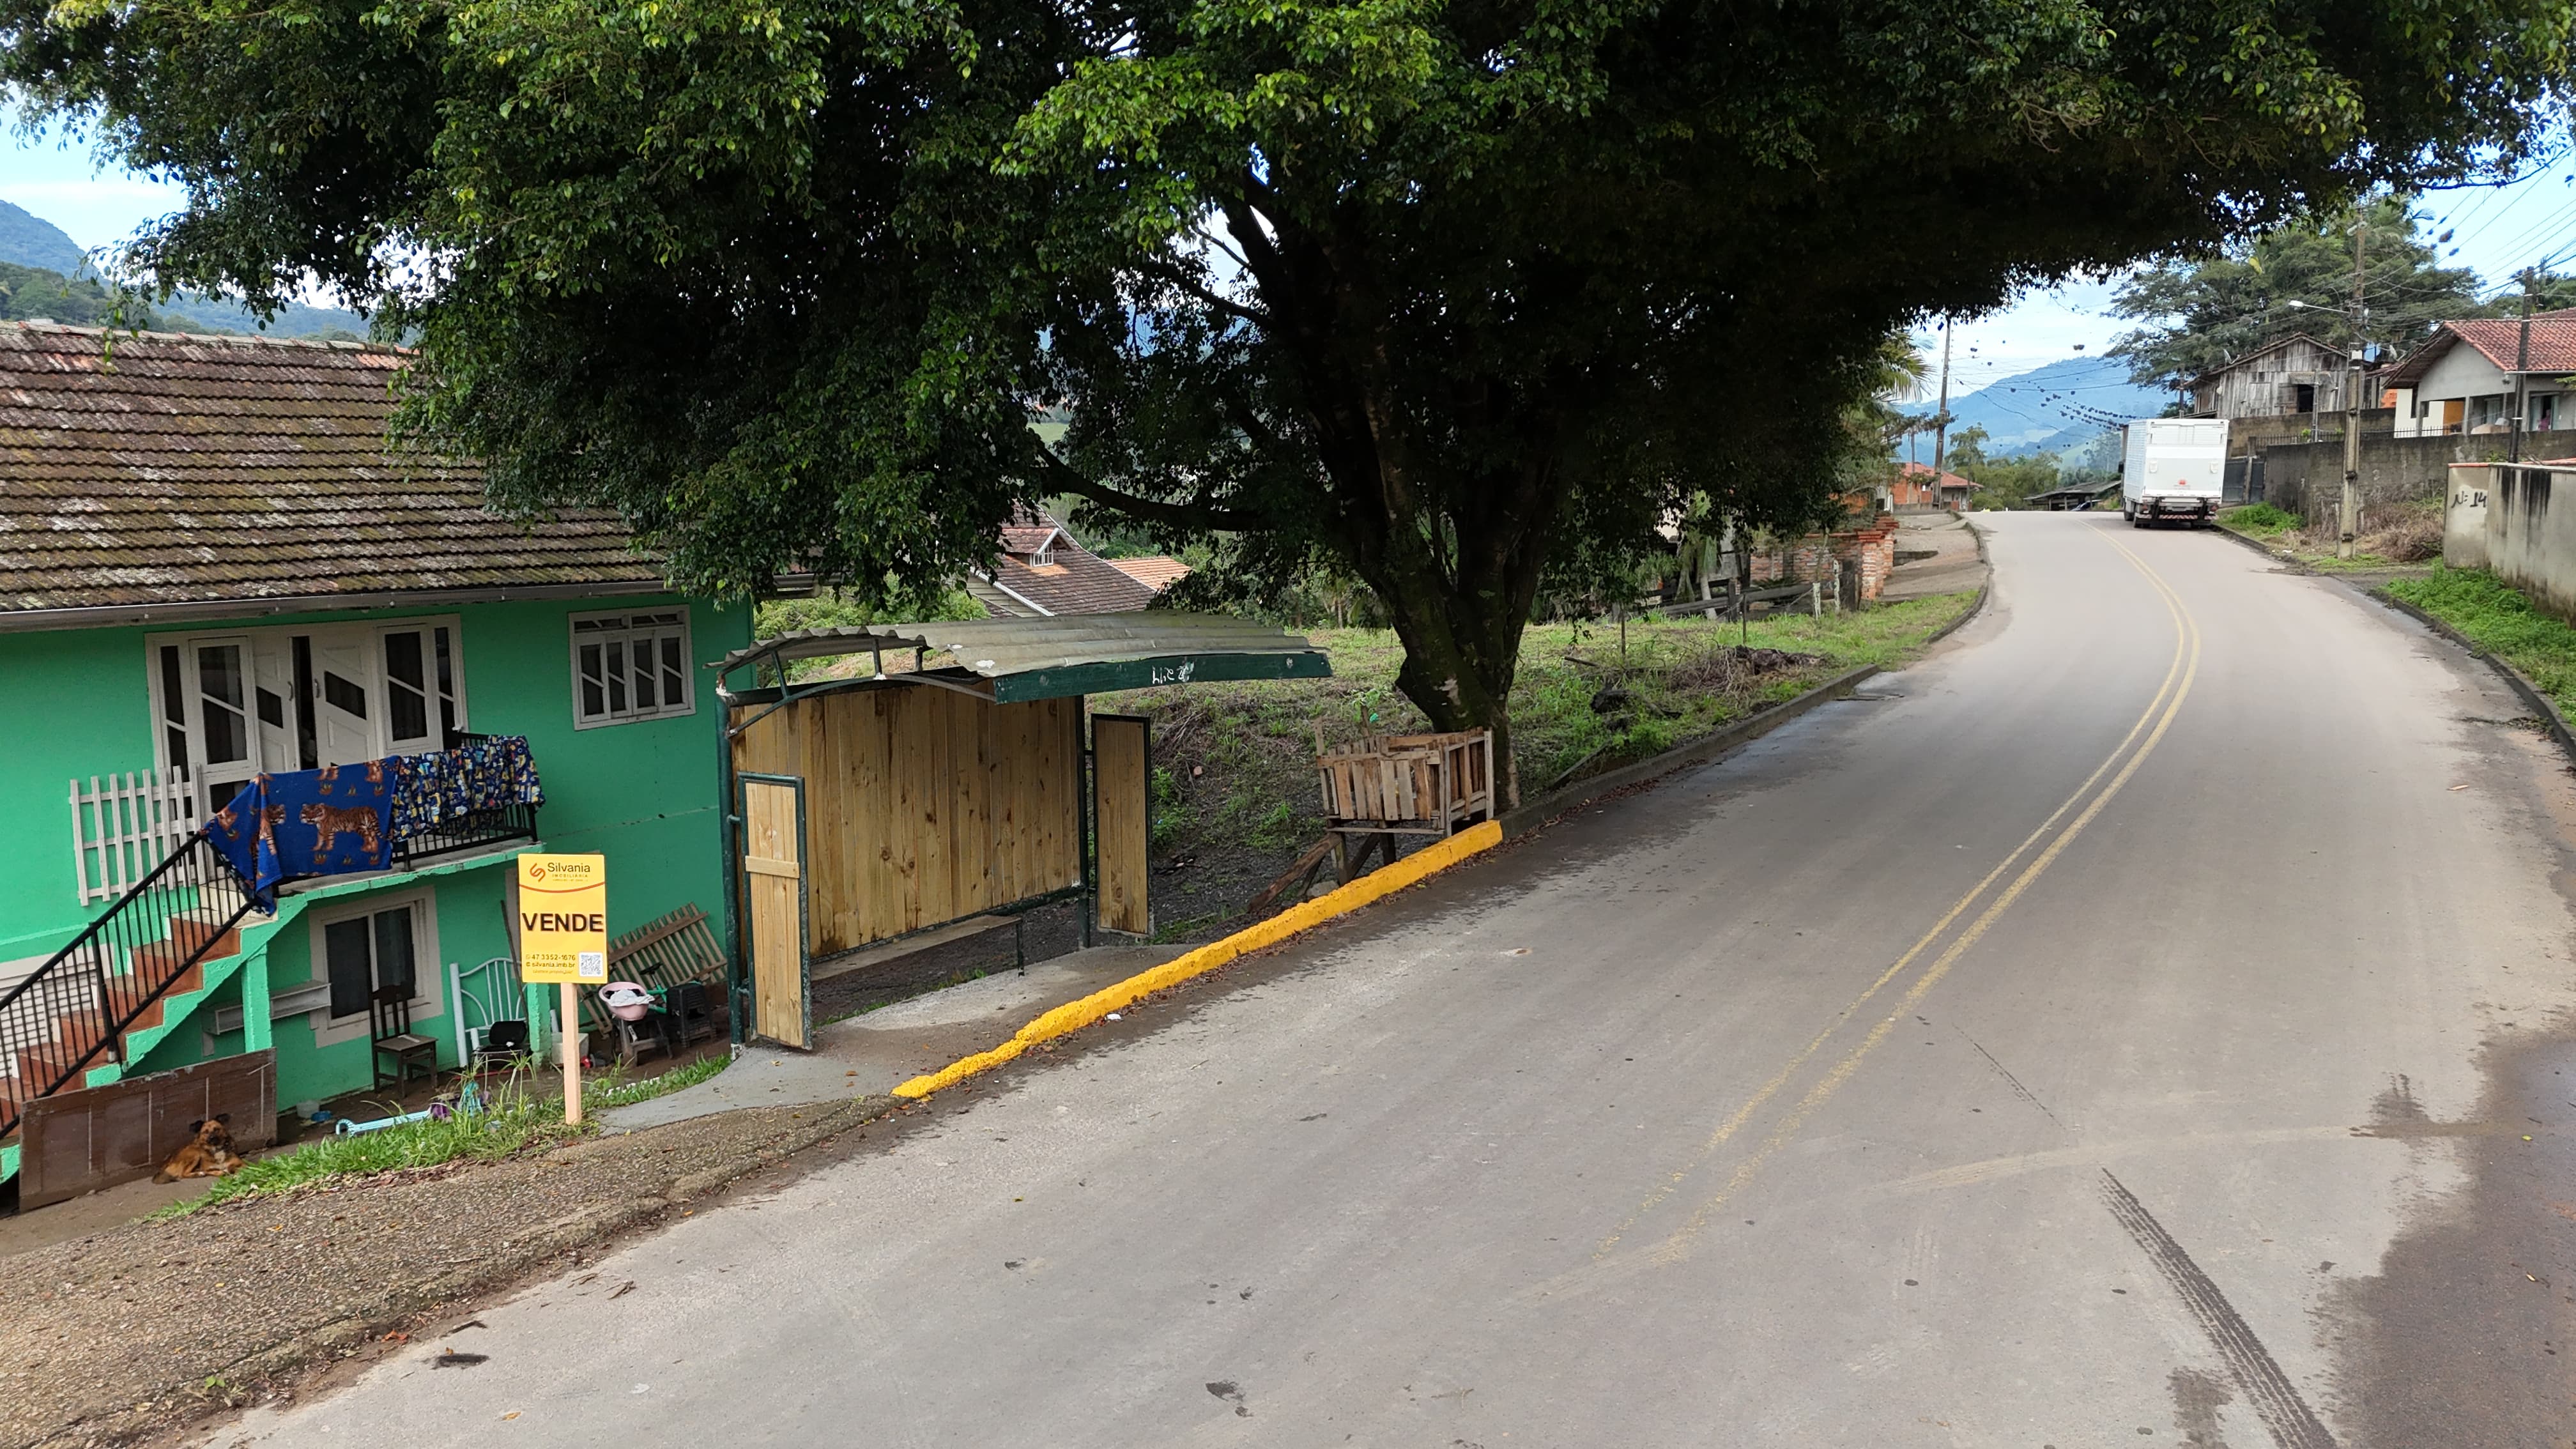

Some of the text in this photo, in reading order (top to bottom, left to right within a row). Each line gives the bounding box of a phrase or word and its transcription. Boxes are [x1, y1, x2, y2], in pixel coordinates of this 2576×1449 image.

[2470, 491, 2487, 508] 14
[548, 862, 591, 873] Silvania
[521, 913, 604, 932] VENDE
